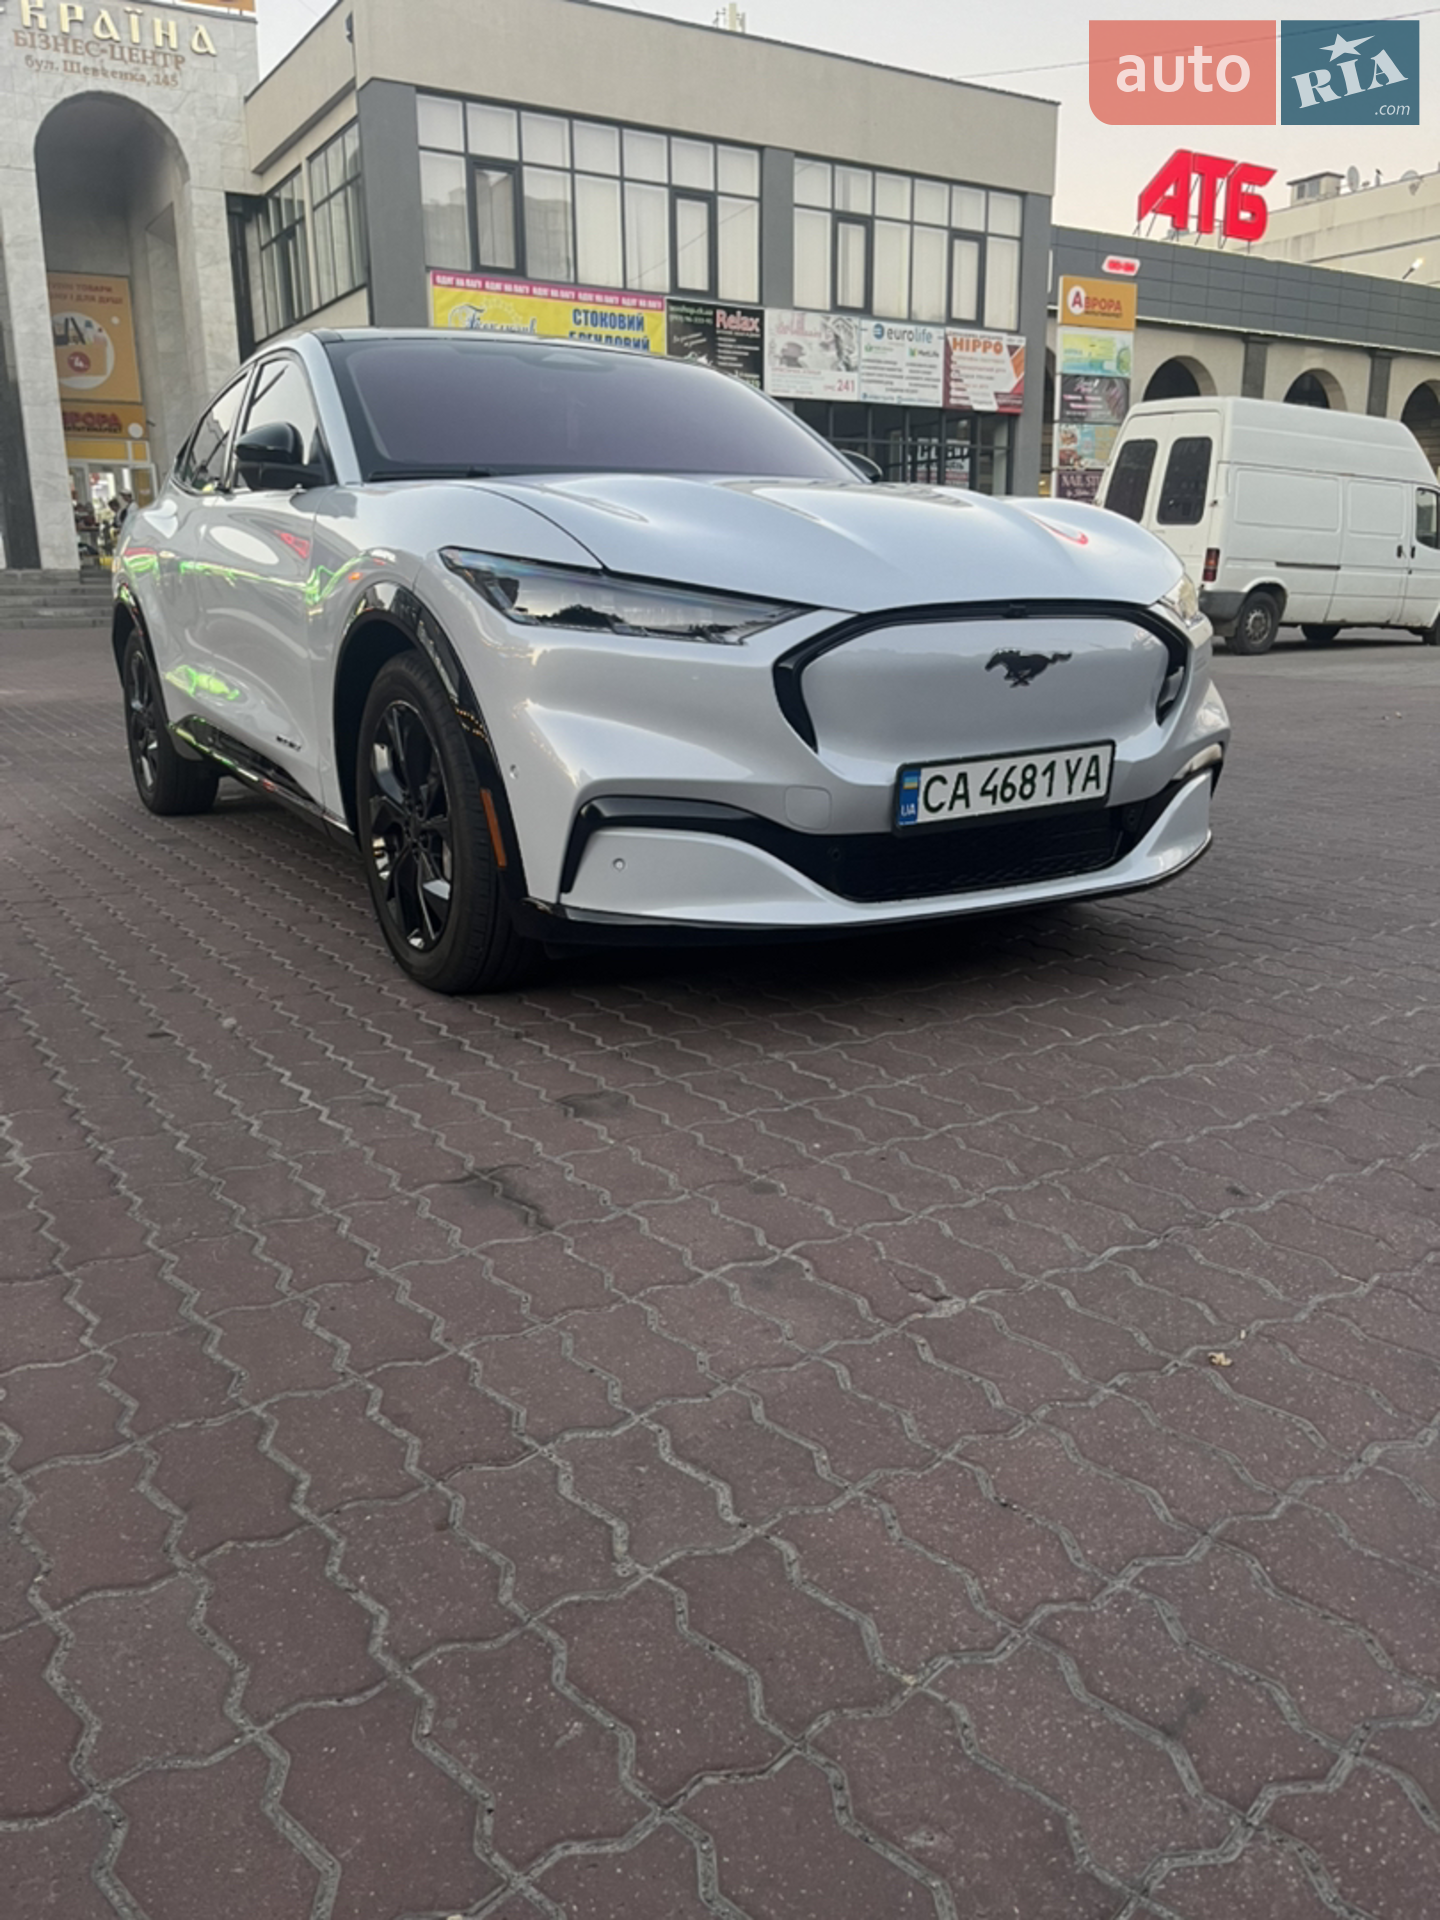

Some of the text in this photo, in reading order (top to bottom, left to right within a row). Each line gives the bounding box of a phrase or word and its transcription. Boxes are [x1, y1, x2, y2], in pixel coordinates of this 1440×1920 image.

[0, 0, 217, 57] КРАЇНА
[13, 29, 186, 70] БІЗНЕС-ЦЕНТР
[1138, 148, 1278, 242] АТБ
[572, 308, 645, 332] СТОКОВИЙ
[715, 309, 760, 333] Relax
[887, 326, 933, 344] eurolife
[952, 337, 1003, 355] HIPPO
[837, 379, 855, 393] 241
[923, 754, 1101, 813] CA 4681 YA
